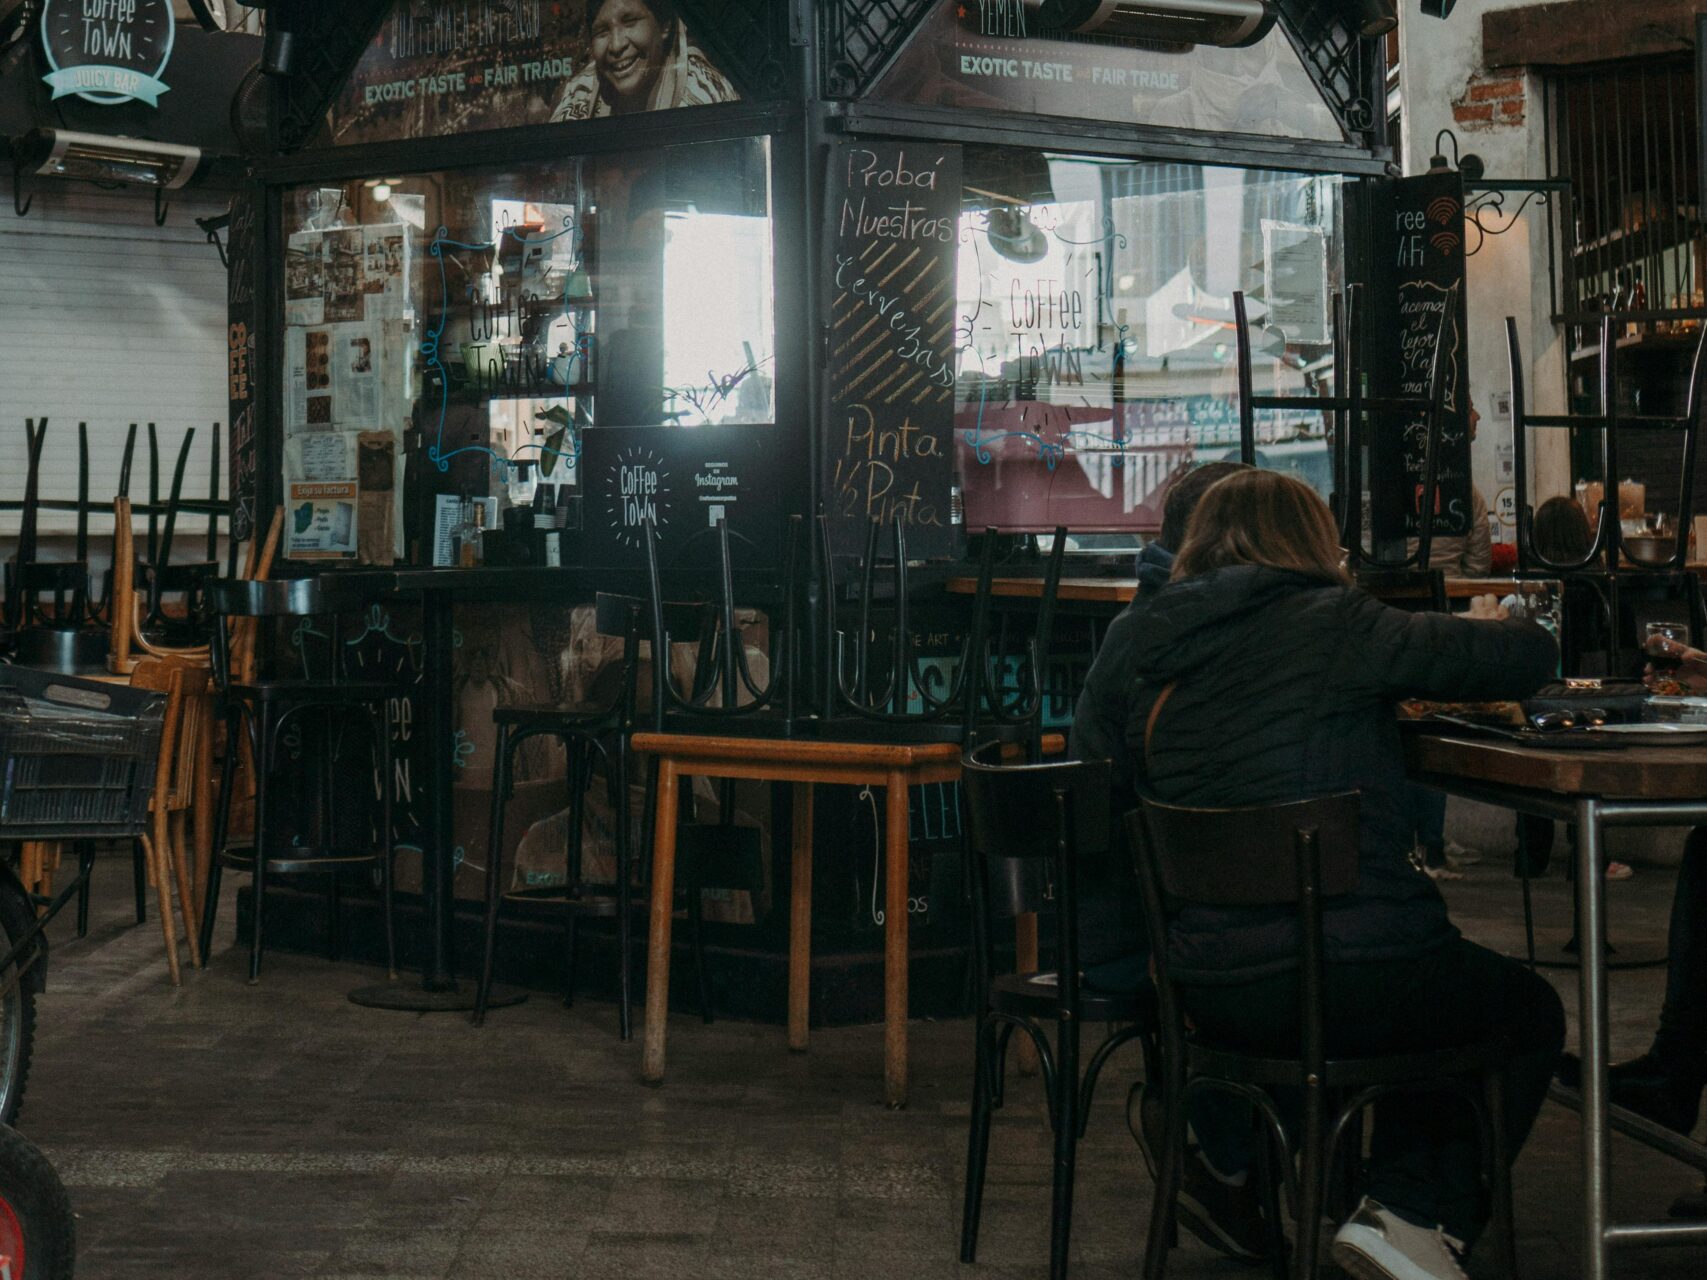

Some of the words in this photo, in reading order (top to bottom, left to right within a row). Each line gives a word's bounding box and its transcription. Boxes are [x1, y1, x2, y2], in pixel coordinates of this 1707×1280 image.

[74, 70, 109, 89] JUICY
[112, 74, 138, 91] BAR
[364, 79, 417, 103] EXOTIC
[418, 72, 467, 97] TASTE
[484, 63, 519, 88] FAIR
[521, 56, 574, 83] TRADE
[960, 55, 1021, 78] EXOTIC
[1023, 61, 1074, 83] TASTE
[1091, 66, 1127, 86] FAIR
[1129, 70, 1180, 90] TRADE
[847, 149, 946, 191] Probá
[840, 196, 953, 243] Nuestras
[694, 473, 739, 491] Instagram
